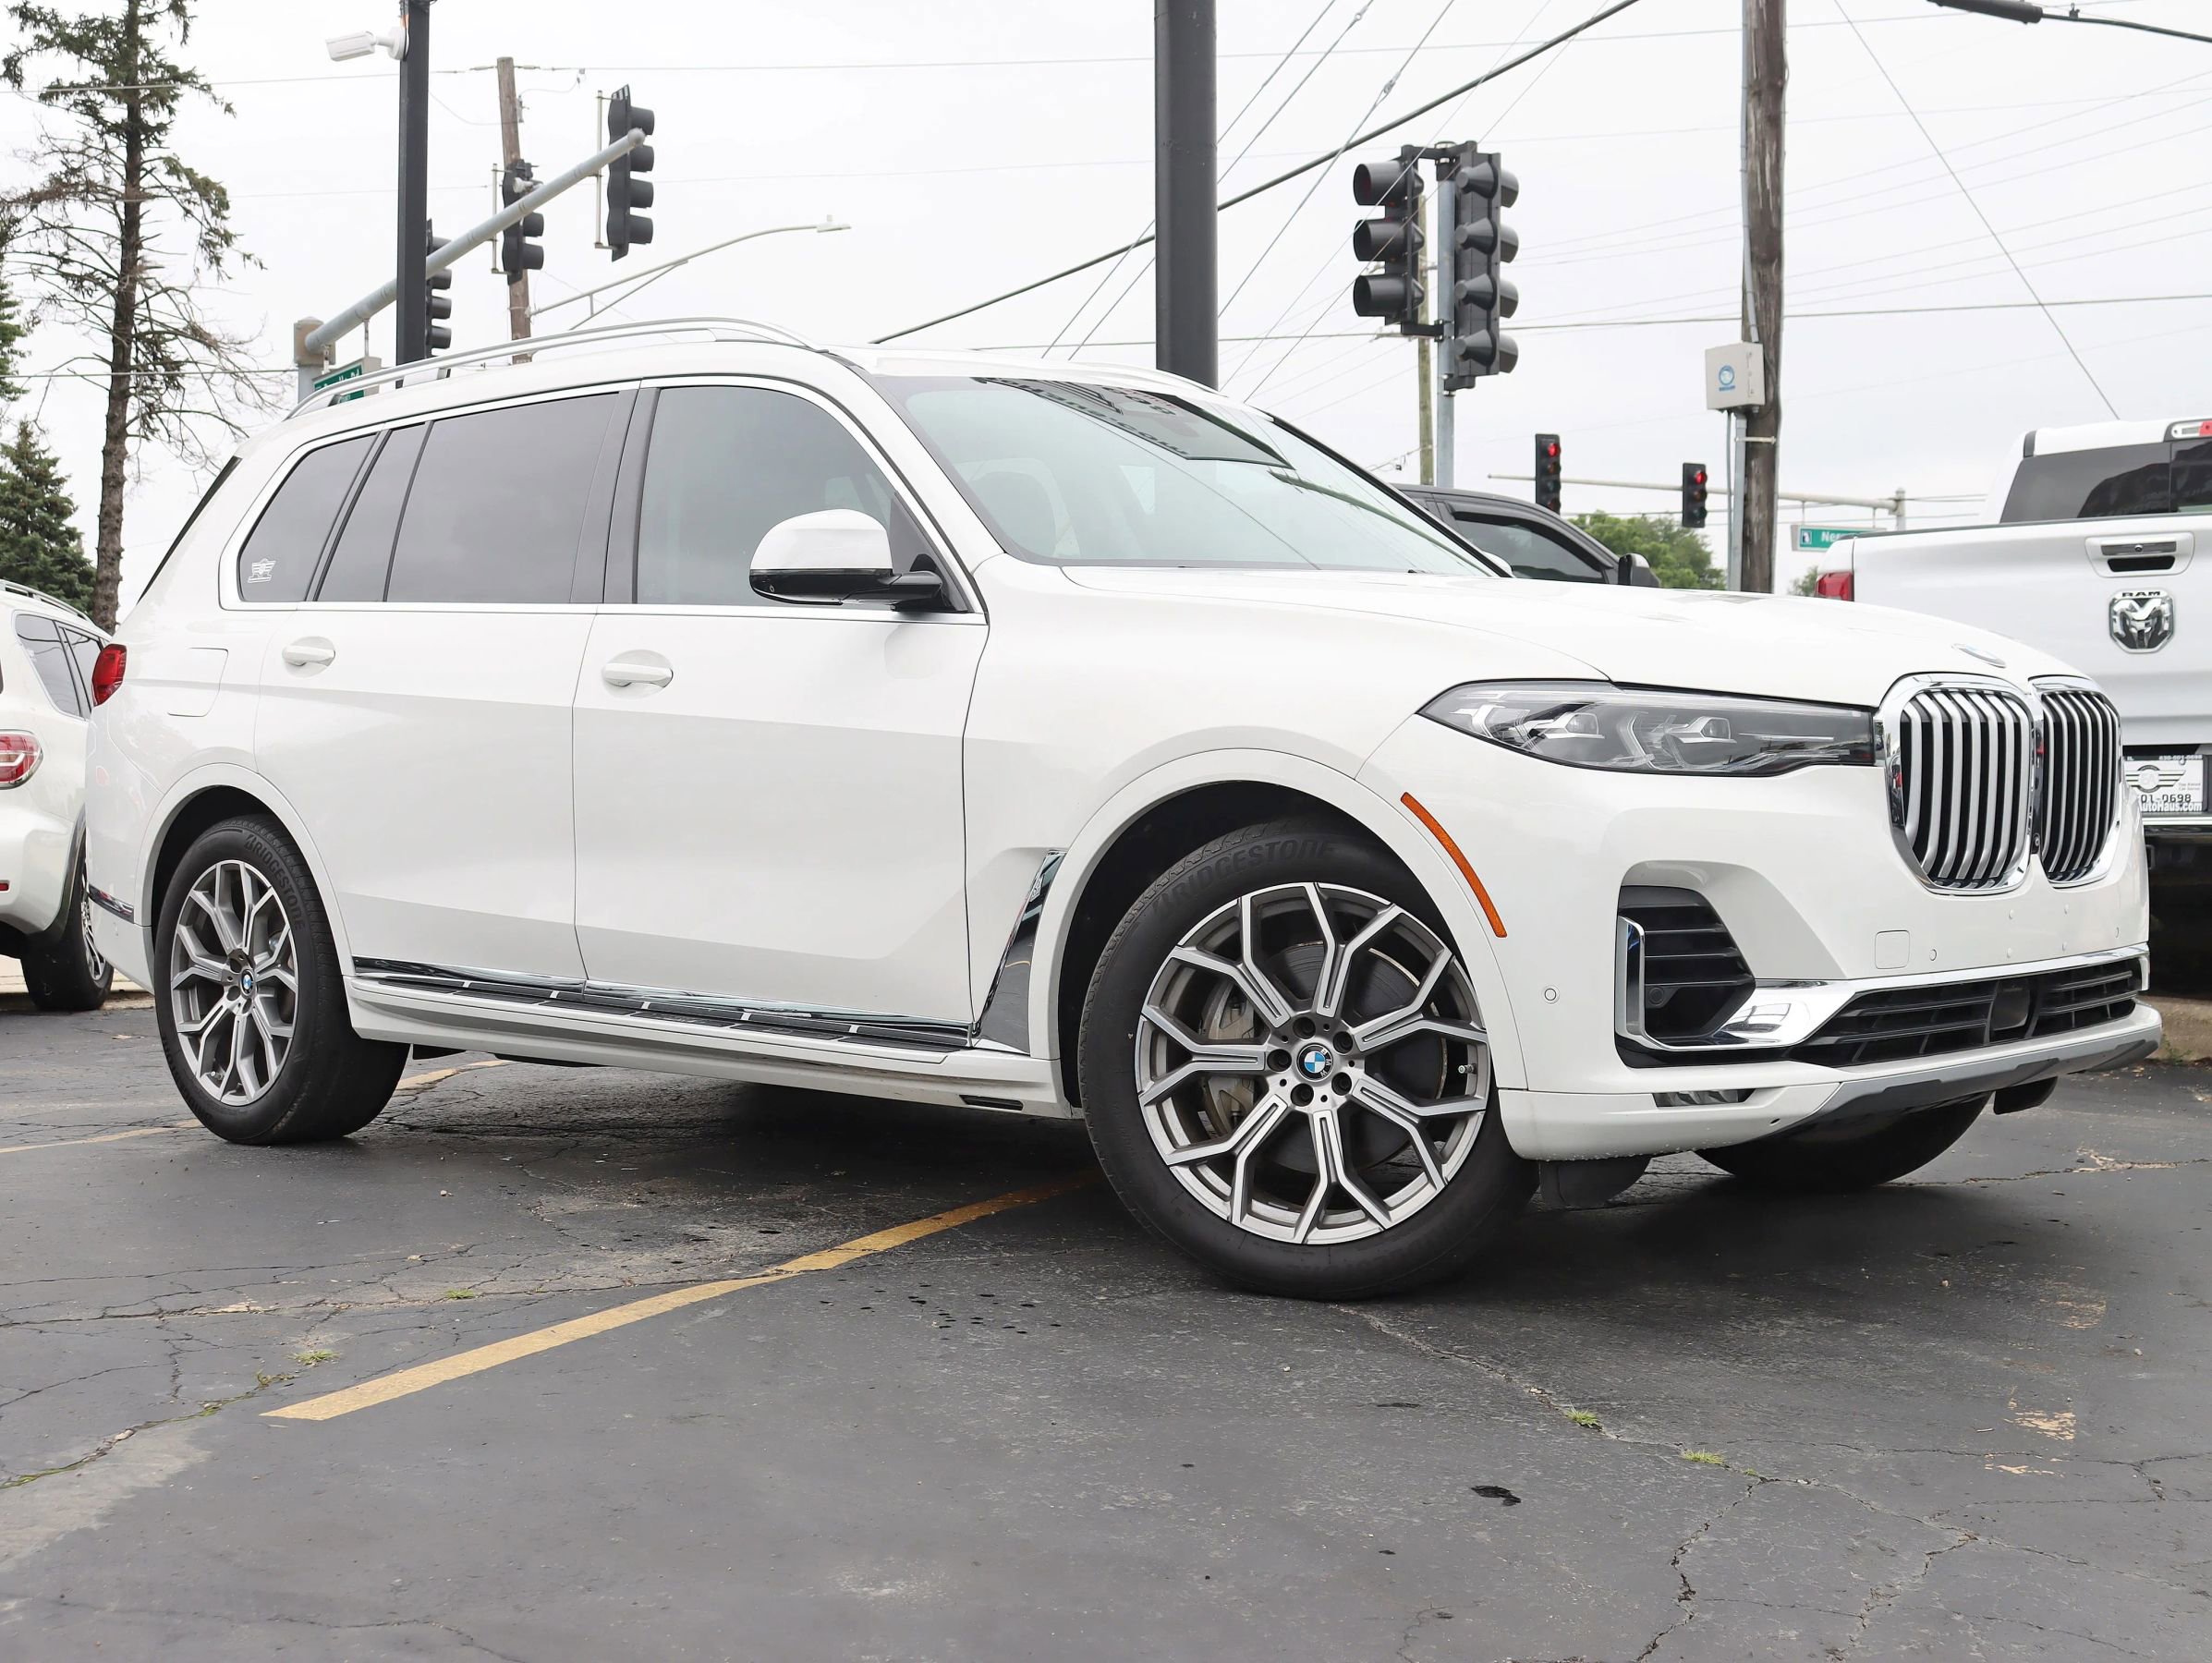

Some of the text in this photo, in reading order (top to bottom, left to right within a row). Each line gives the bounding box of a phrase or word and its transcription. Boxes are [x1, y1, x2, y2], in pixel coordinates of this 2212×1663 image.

[2140, 794, 2192, 803] 01-0698
[2140, 801, 2203, 812] utoHaus.com
[244, 833, 306, 930] BRIDGESTONE
[1154, 838, 1335, 912] BRIDGESTONE
